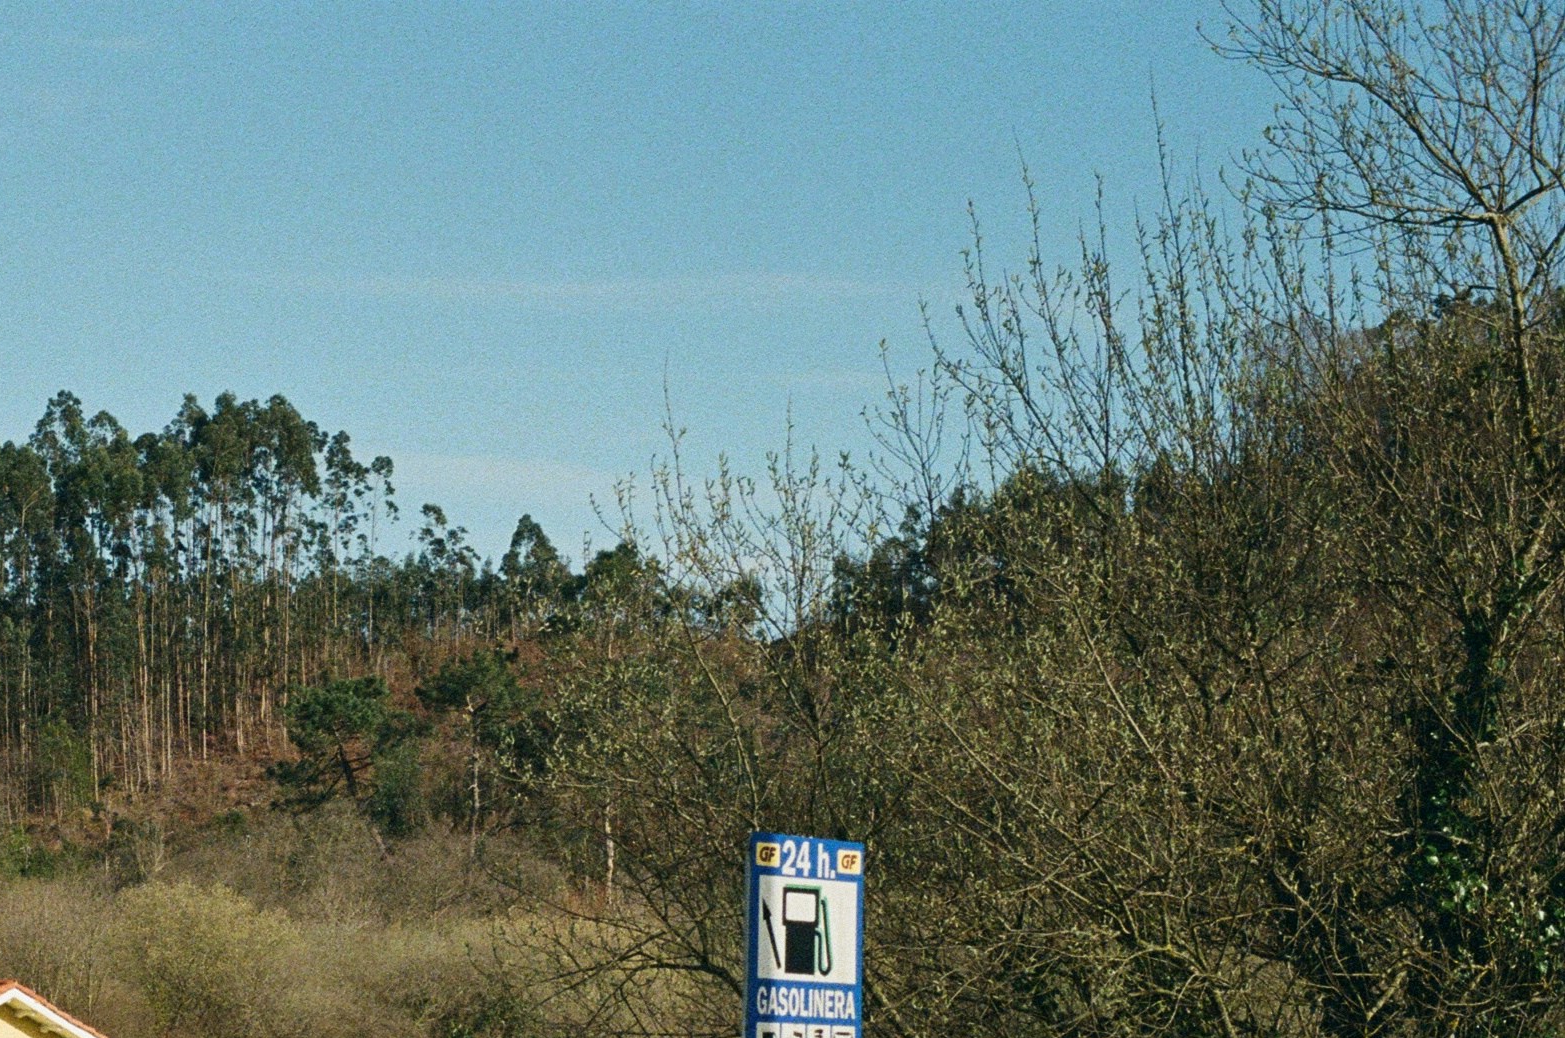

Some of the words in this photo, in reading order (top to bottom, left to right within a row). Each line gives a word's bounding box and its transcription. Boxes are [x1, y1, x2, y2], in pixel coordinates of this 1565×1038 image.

[782, 840, 811, 877] 24
[817, 843, 835, 879] h.
[756, 986, 855, 1020] GASOLINERA
